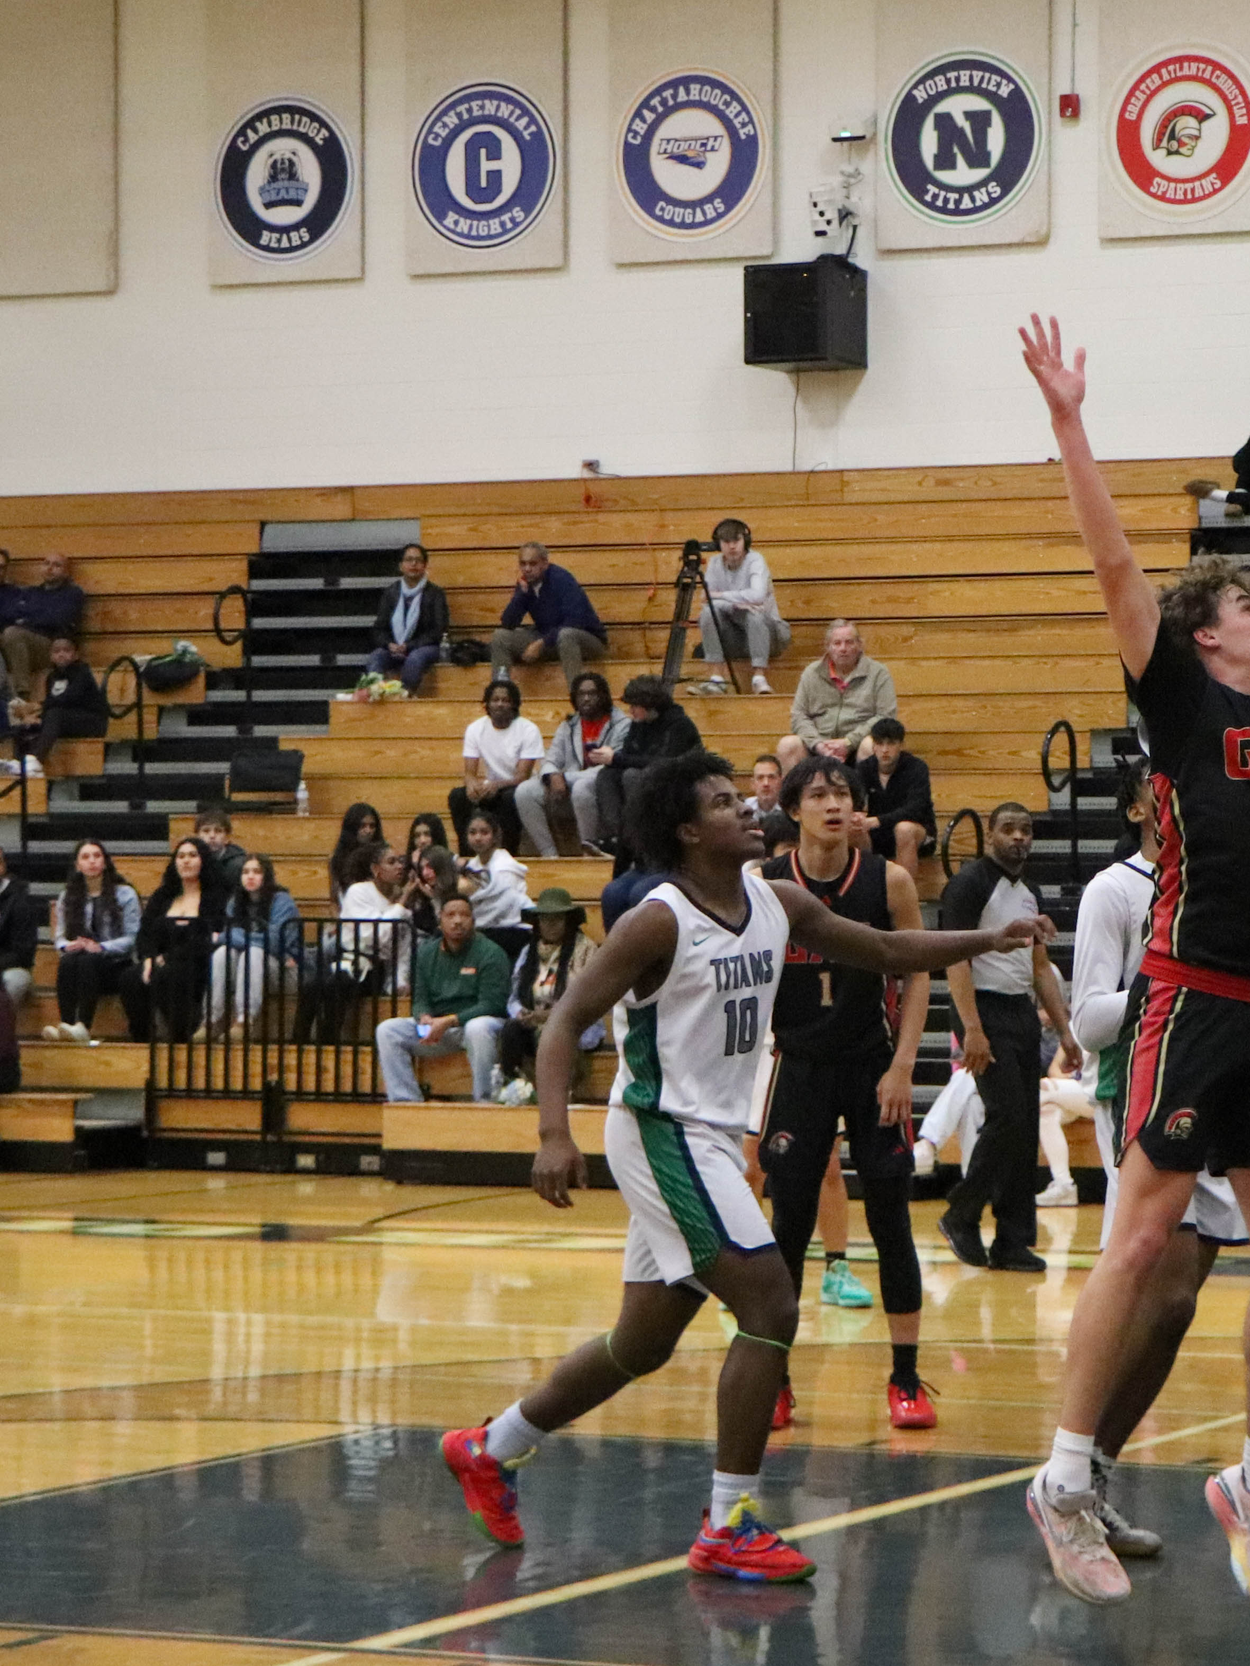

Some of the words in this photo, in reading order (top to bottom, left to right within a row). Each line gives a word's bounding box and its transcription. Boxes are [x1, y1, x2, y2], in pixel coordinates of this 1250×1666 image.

[912, 70, 1015, 103] NORTHVIEW
[1125, 73, 1162, 121] GREATER
[1160, 62, 1213, 82] ATLANTA
[1211, 70, 1248, 125] CHRISTIAN
[237, 113, 330, 151] CAMBRIDGE
[427, 99, 537, 146] CENTENNIAL
[627, 84, 754, 145] CHATTAHOOCHEE
[933, 109, 992, 171] N
[465, 131, 502, 204] C
[1150, 172, 1222, 199] SPARTANS
[655, 198, 725, 224] COUGARS
[924, 181, 1001, 210] TITANS
[259, 227, 310, 248] BEARS
[443, 206, 525, 236] KNIGHTS
[710, 949, 774, 993] TITANS
[818, 970, 834, 1007] 1
[724, 996, 759, 1057] 10
